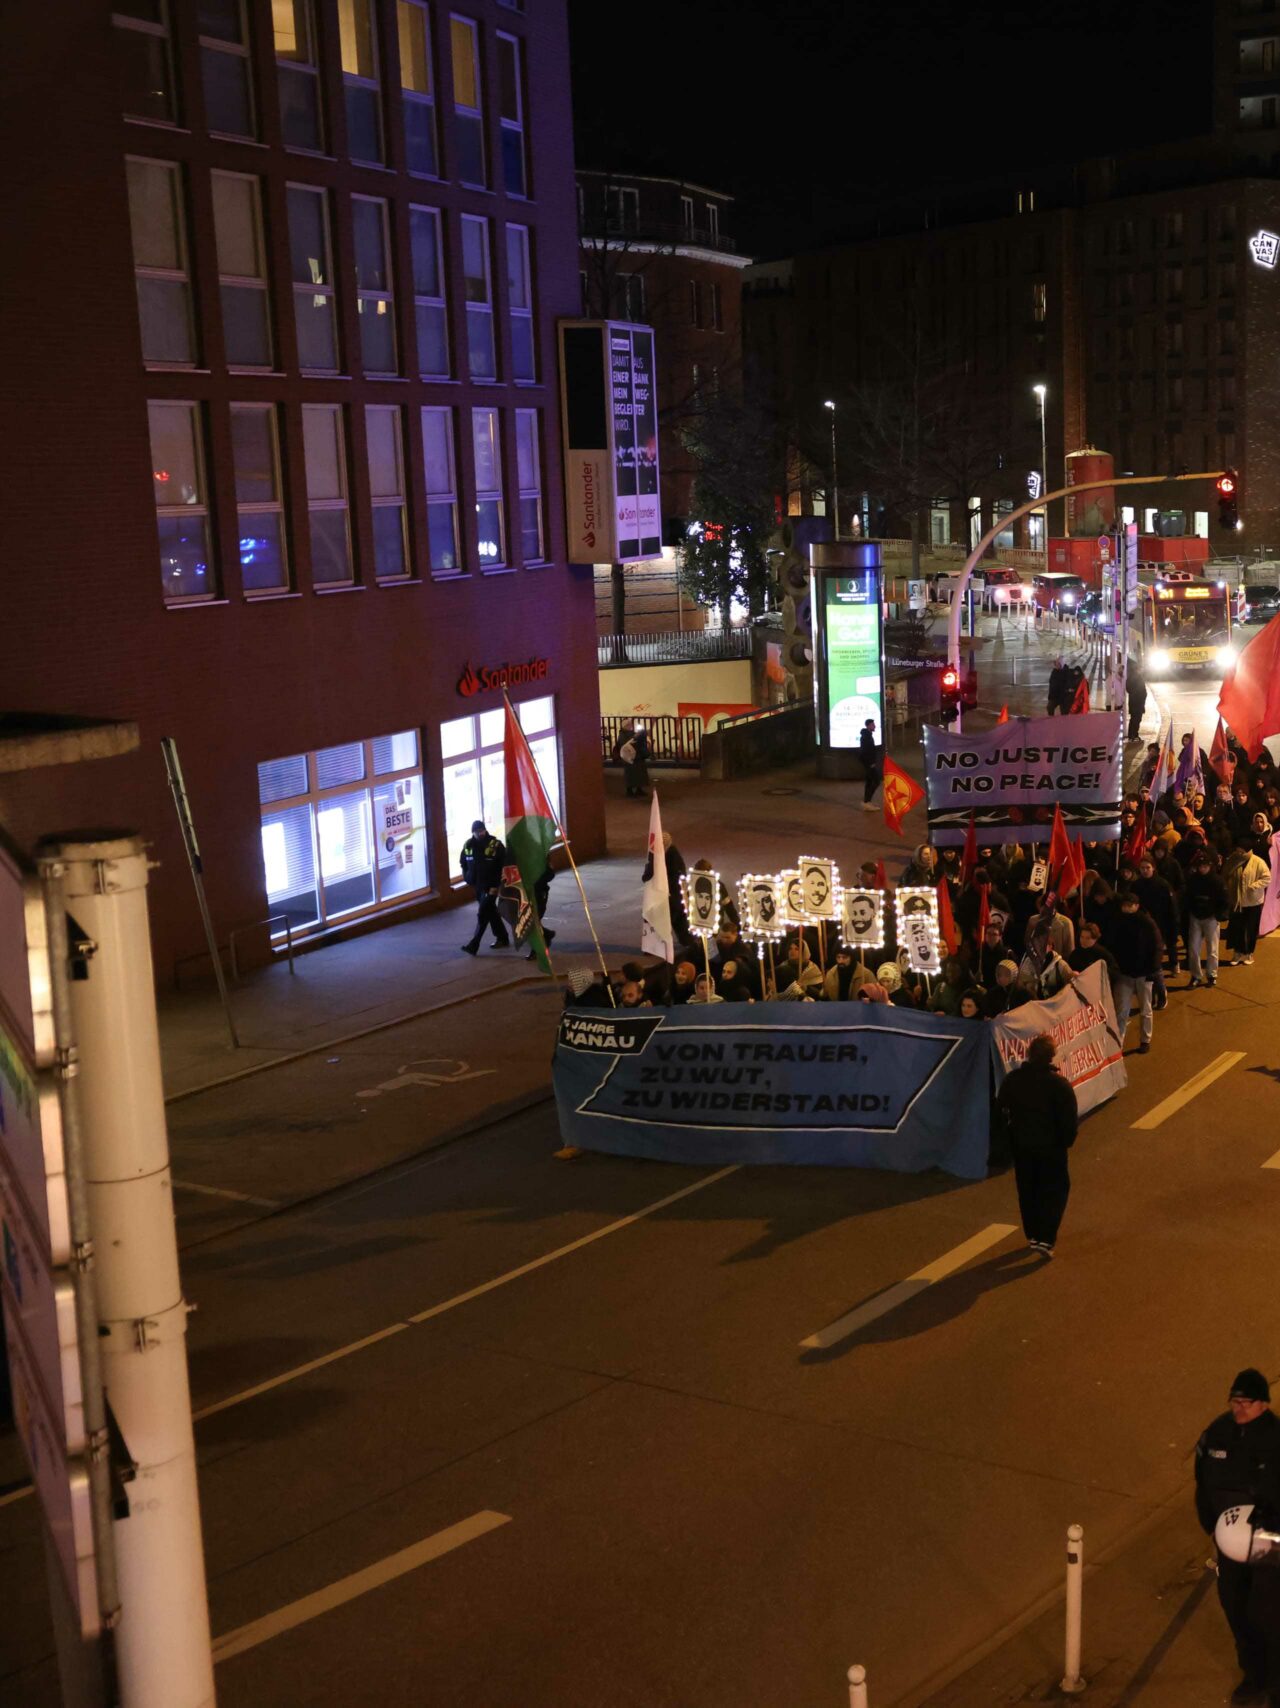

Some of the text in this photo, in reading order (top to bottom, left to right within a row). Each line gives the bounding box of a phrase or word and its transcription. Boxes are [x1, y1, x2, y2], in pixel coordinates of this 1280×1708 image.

[1255, 247, 1273, 256] VAS
[613, 371, 650, 385] EINER BANK
[582, 461, 595, 530] Santander
[891, 657, 924, 668] Lüneburger
[481, 657, 552, 693] Santander
[936, 746, 1113, 770] NO JUSTICE,
[952, 773, 1102, 793] NO PEACE!
[385, 806, 396, 814] DAS
[386, 812, 411, 828] BESTE
[571, 1020, 616, 1034] JAHRE
[656, 1043, 868, 1065] VON TRAUER,
[640, 1067, 773, 1088] ZU WUT,
[621, 1089, 891, 1114] ZU WIDERSTAND!
